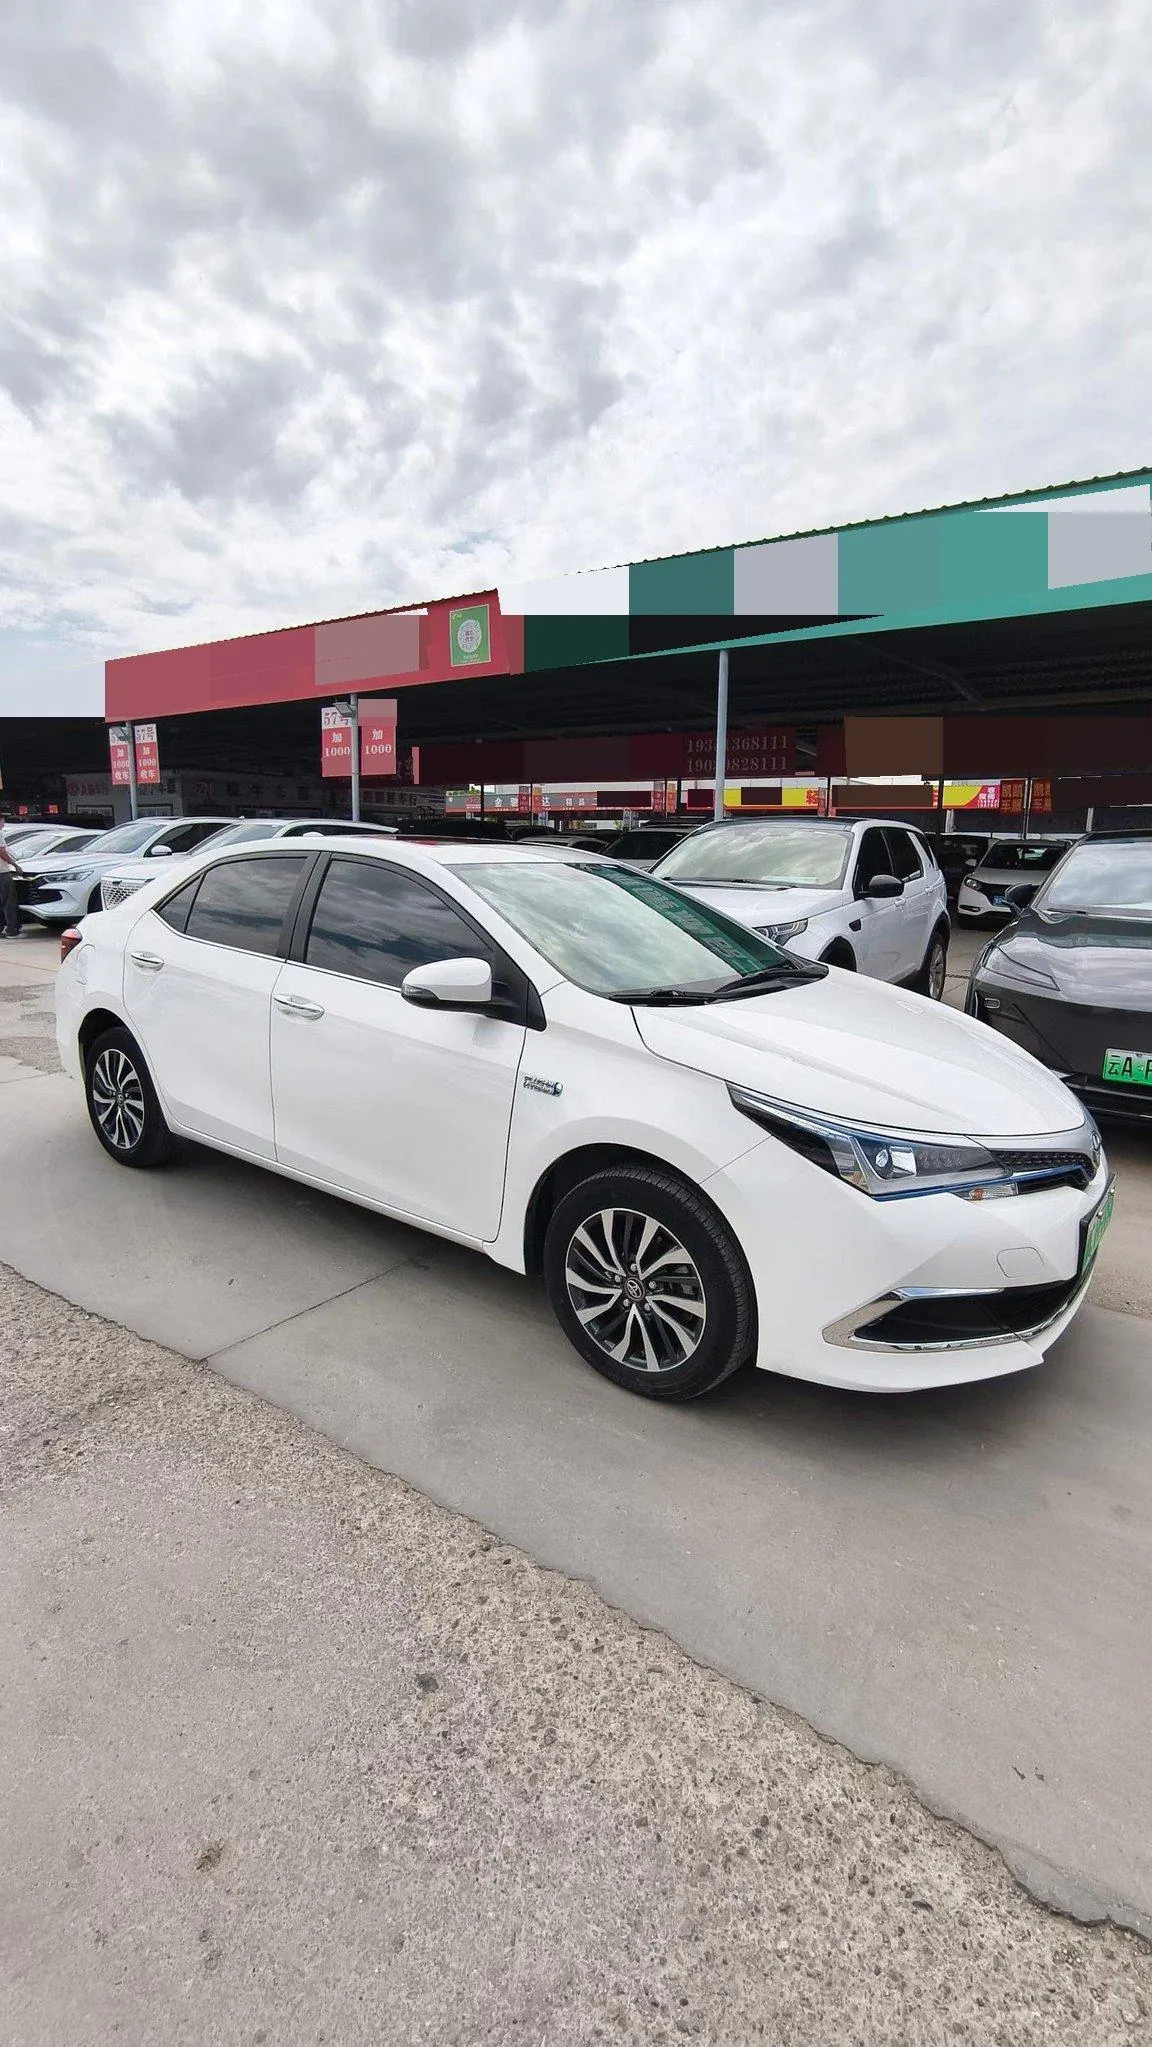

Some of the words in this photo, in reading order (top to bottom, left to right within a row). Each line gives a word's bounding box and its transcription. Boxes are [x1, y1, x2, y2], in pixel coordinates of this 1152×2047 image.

[136, 726, 155, 740] 57号
[332, 732, 343, 743] 加
[372, 729, 384, 740] 加
[365, 744, 392, 754] 1000
[687, 736, 787, 753] 193368111
[325, 746, 350, 756] 1000
[113, 760, 130, 768] 1000
[139, 759, 157, 767] 1000
[687, 757, 787, 773] 190828111
